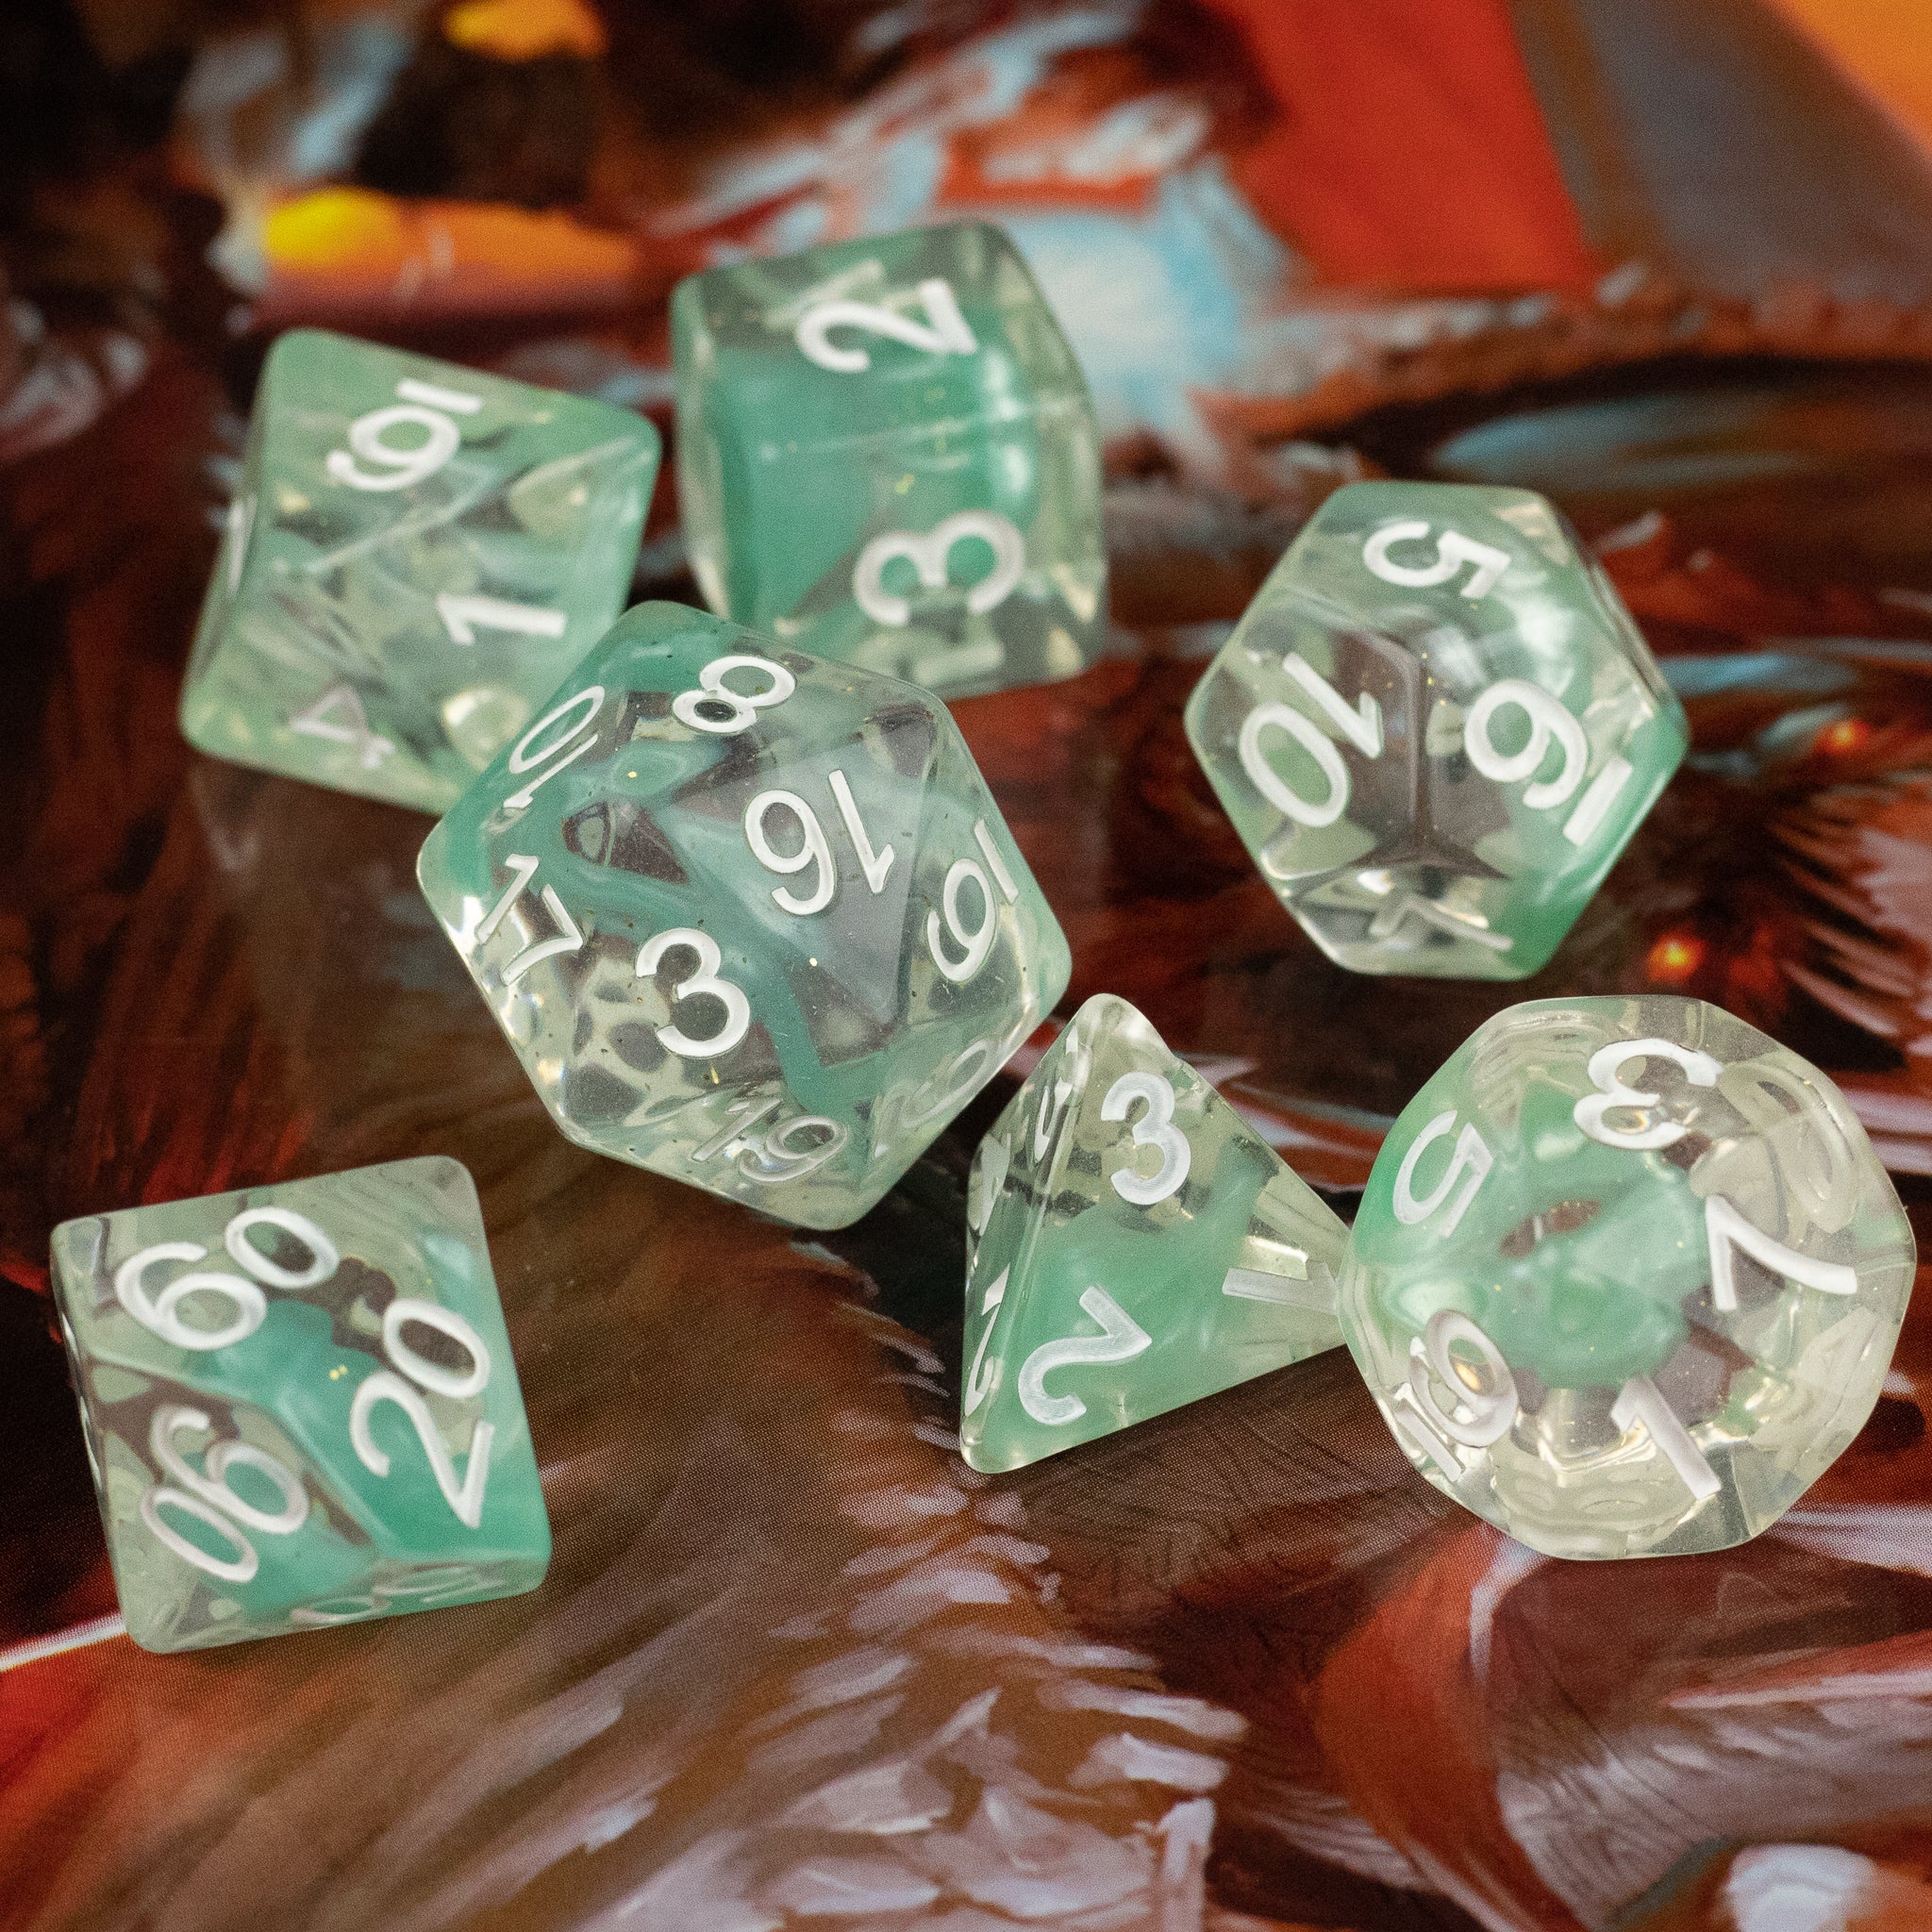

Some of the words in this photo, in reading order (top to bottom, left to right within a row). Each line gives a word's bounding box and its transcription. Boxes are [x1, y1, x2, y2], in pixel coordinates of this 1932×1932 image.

[796, 277, 976, 372] 2
[437, 594, 565, 645] 1
[853, 508, 1024, 626] 3
[1363, 521, 1510, 599] 5
[508, 685, 606, 809] 10
[672, 656, 797, 733] 8
[1239, 652, 1384, 828] 10
[744, 769, 894, 915] 16
[477, 853, 585, 987] 17
[635, 927, 751, 1058] 3
[1100, 1072, 1191, 1205] 3
[1573, 1037, 1724, 1150] 3
[115, 1206, 340, 1351] 60
[1704, 1195, 1857, 1311] 7
[350, 1298, 494, 1528] 20
[1018, 1286, 1153, 1425] 2
